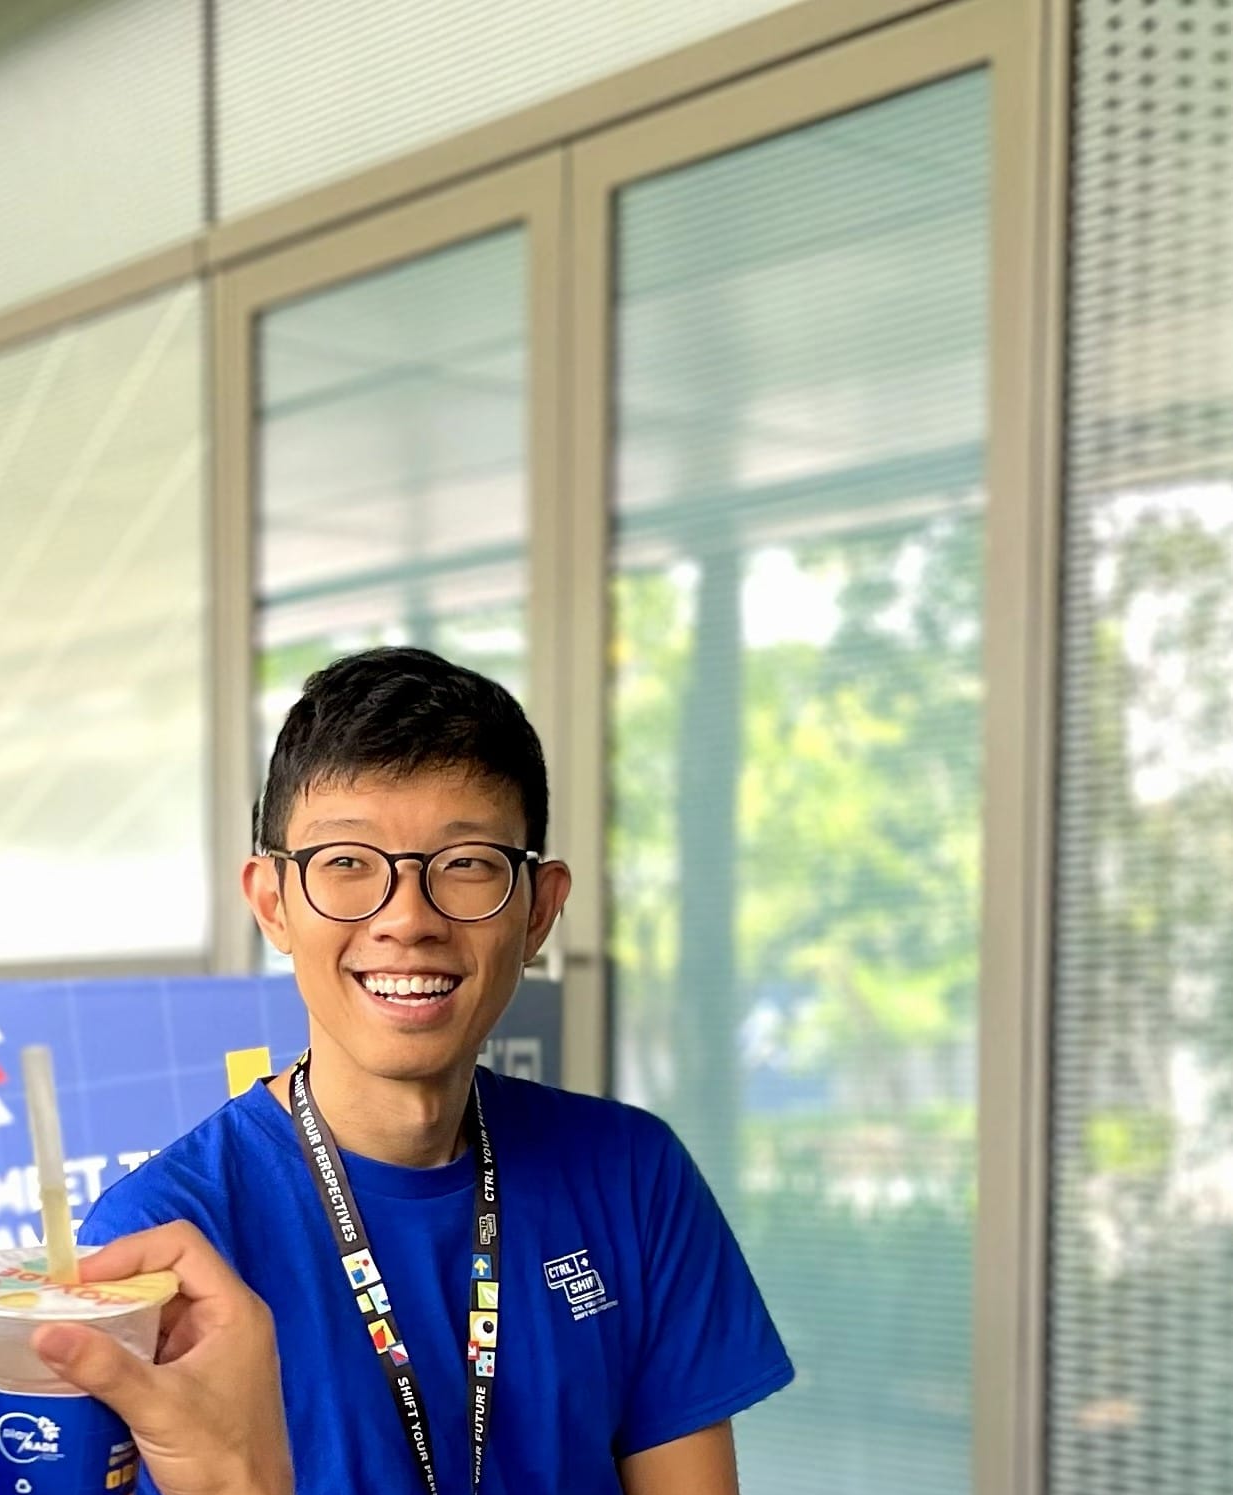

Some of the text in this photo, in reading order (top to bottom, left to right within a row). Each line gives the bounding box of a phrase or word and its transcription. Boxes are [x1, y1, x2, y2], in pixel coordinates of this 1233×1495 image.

[294, 1069, 358, 1243] SHIFT YOUR PERSPECTIVES
[481, 1129, 493, 1164] YOUR
[484, 1168, 495, 1202] CTRL
[548, 1262, 575, 1279] CTRL
[569, 1275, 596, 1295] SHIF
[397, 1376, 429, 1462] SHIFT YOUR
[474, 1385, 487, 1442] FUTURE
